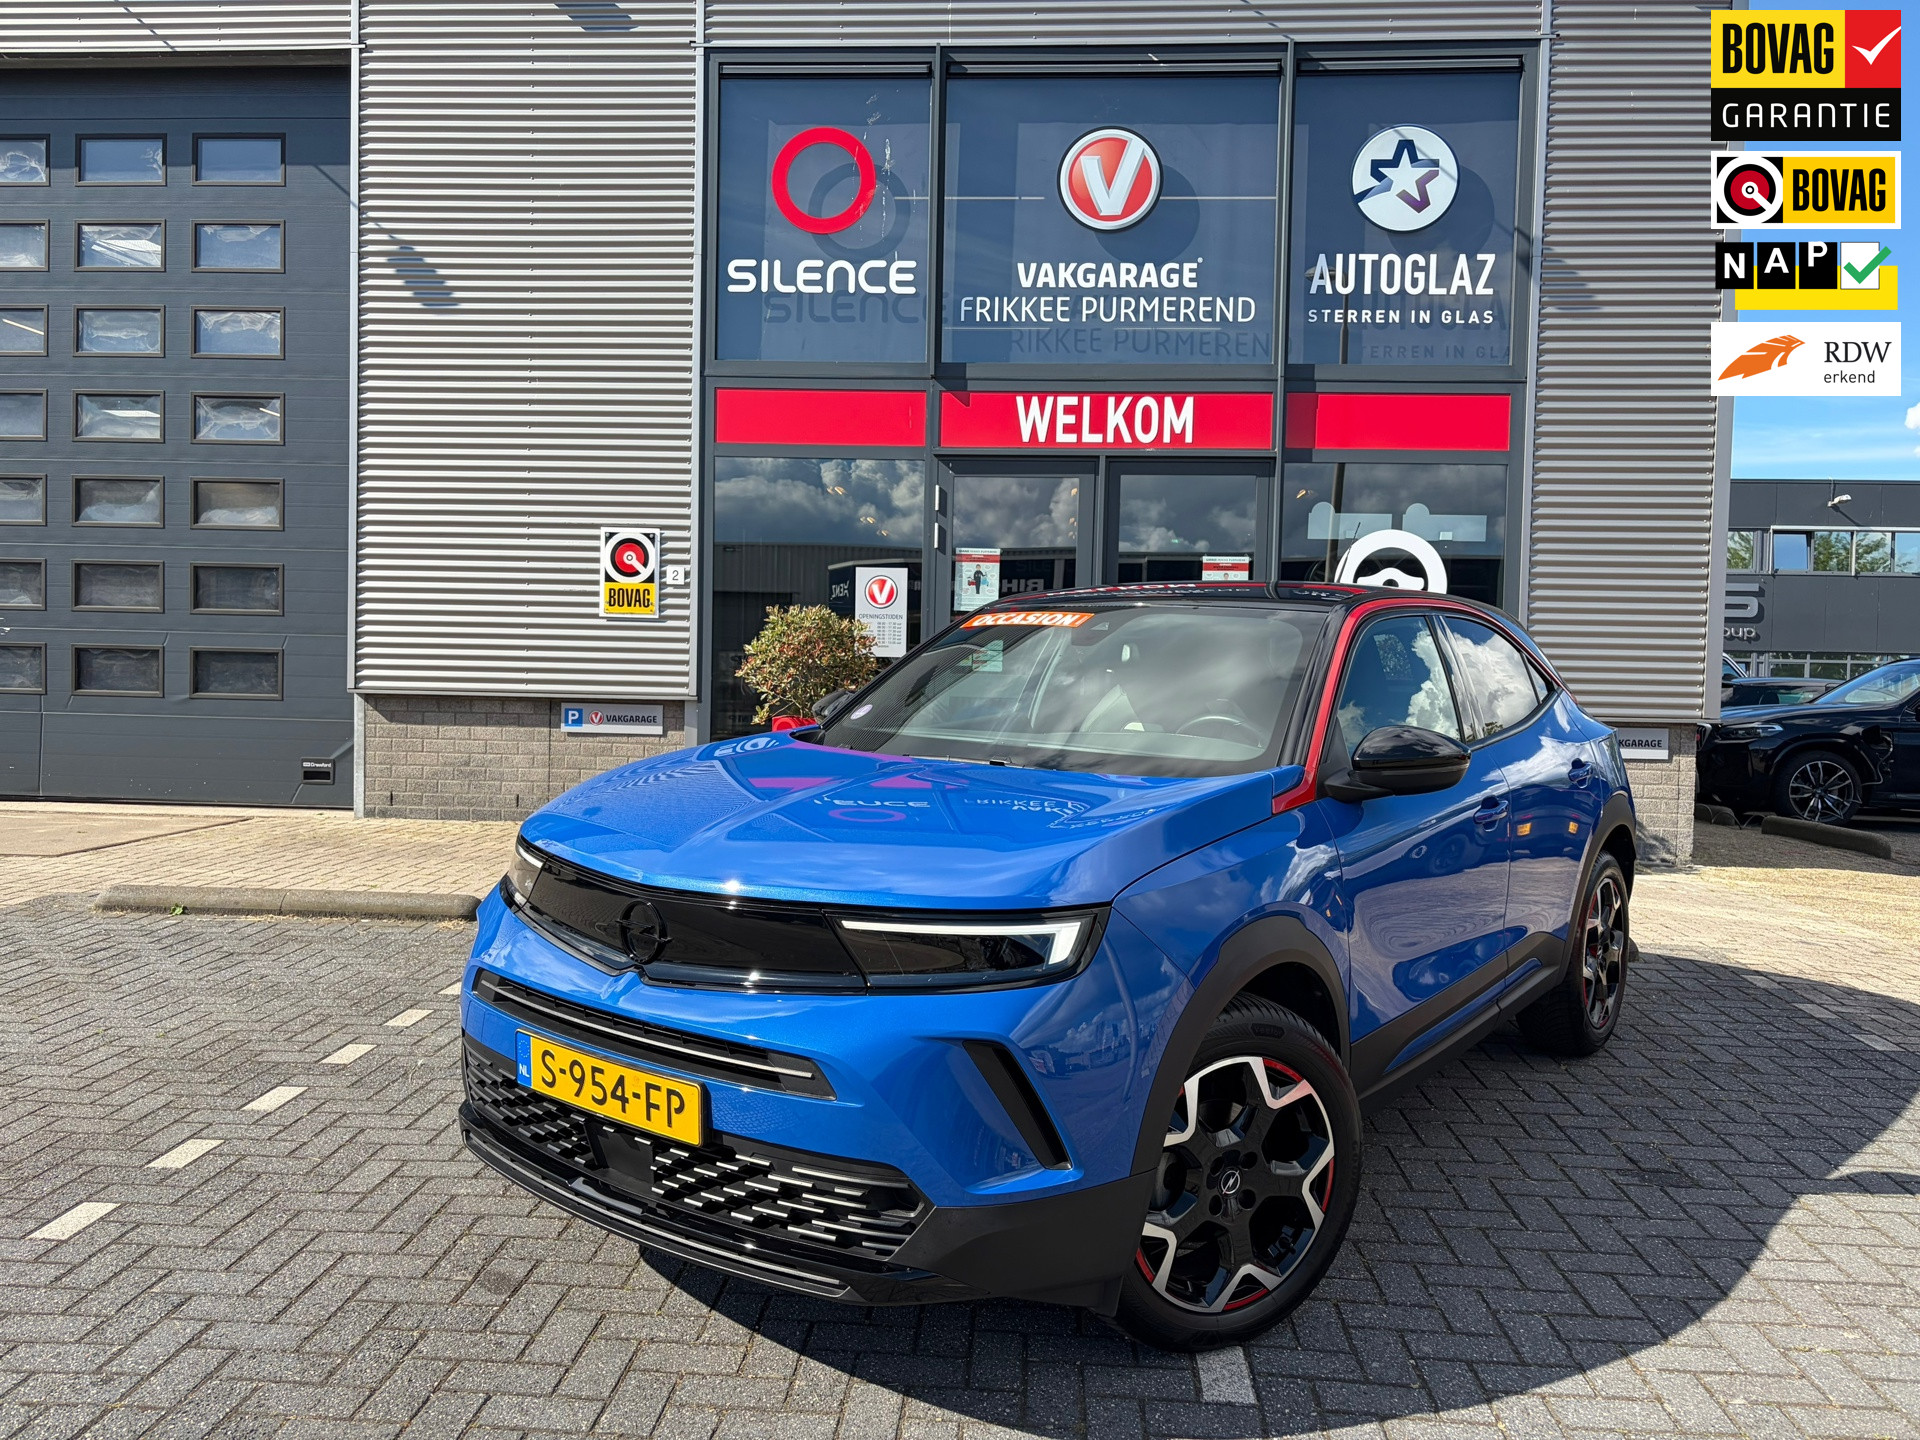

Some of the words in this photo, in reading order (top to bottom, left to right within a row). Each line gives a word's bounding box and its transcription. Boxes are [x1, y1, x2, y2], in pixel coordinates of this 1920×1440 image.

[1081, 138, 1145, 215] V
[727, 259, 917, 294] SILENCE
[1017, 262, 1198, 288] VAKGARAGE
[1309, 253, 1496, 295] AUTOGLAZ
[960, 296, 1071, 322] FRIKKEE
[1082, 296, 1256, 323] PURMEREND
[1308, 309, 1400, 323] STERREN
[1411, 310, 1431, 324] IN
[1441, 310, 1494, 324] GLAS
[1016, 396, 1195, 444] WELKOM
[672, 570, 679, 581] 2
[608, 588, 650, 608] BOVAG
[568, 711, 579, 725] P
[606, 714, 657, 723] VAKGARAGE
[519, 1063, 530, 1078] NL
[541, 1049, 685, 1129] S-954-FP
